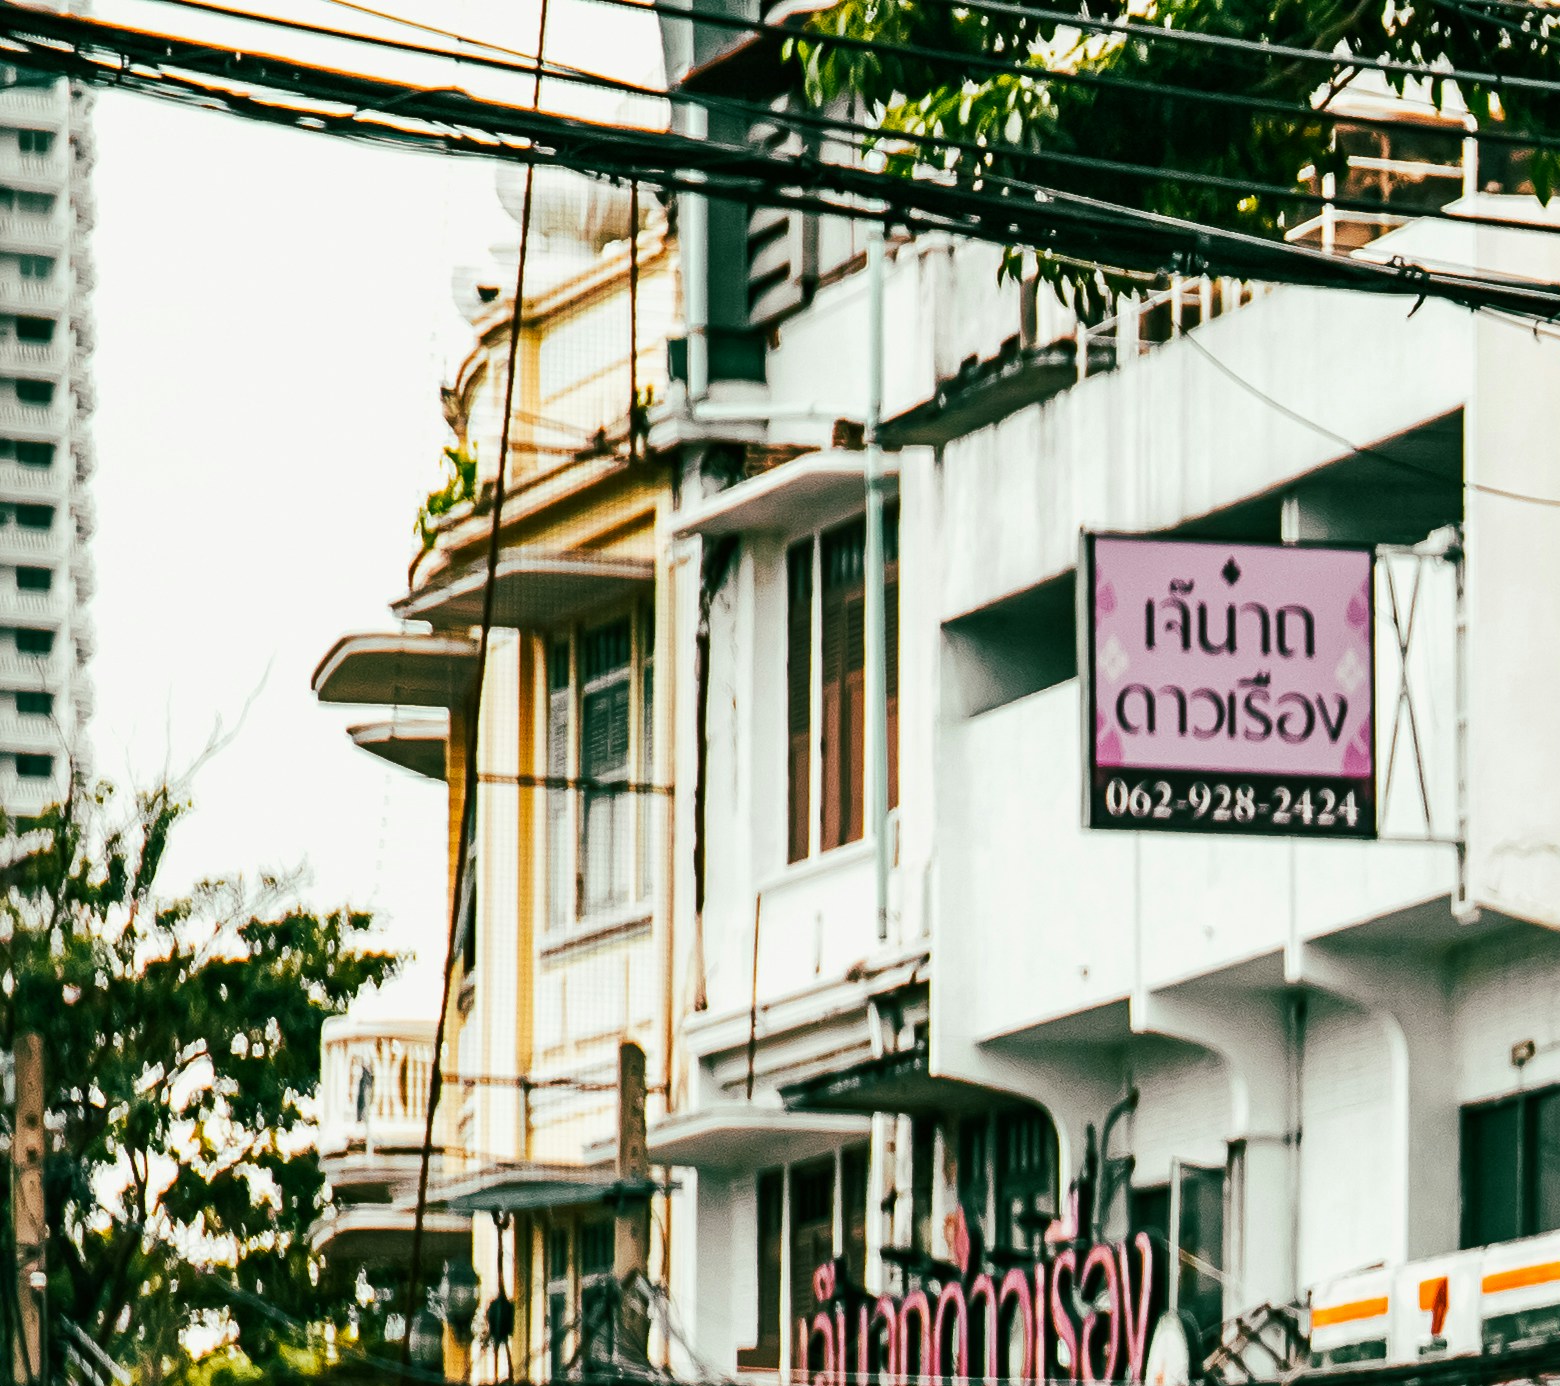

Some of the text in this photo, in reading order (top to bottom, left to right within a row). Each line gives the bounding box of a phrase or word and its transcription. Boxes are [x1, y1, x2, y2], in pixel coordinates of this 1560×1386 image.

[1115, 669, 1349, 744] ดาวเรือง
[1105, 777, 1360, 827] 062-928-2424
